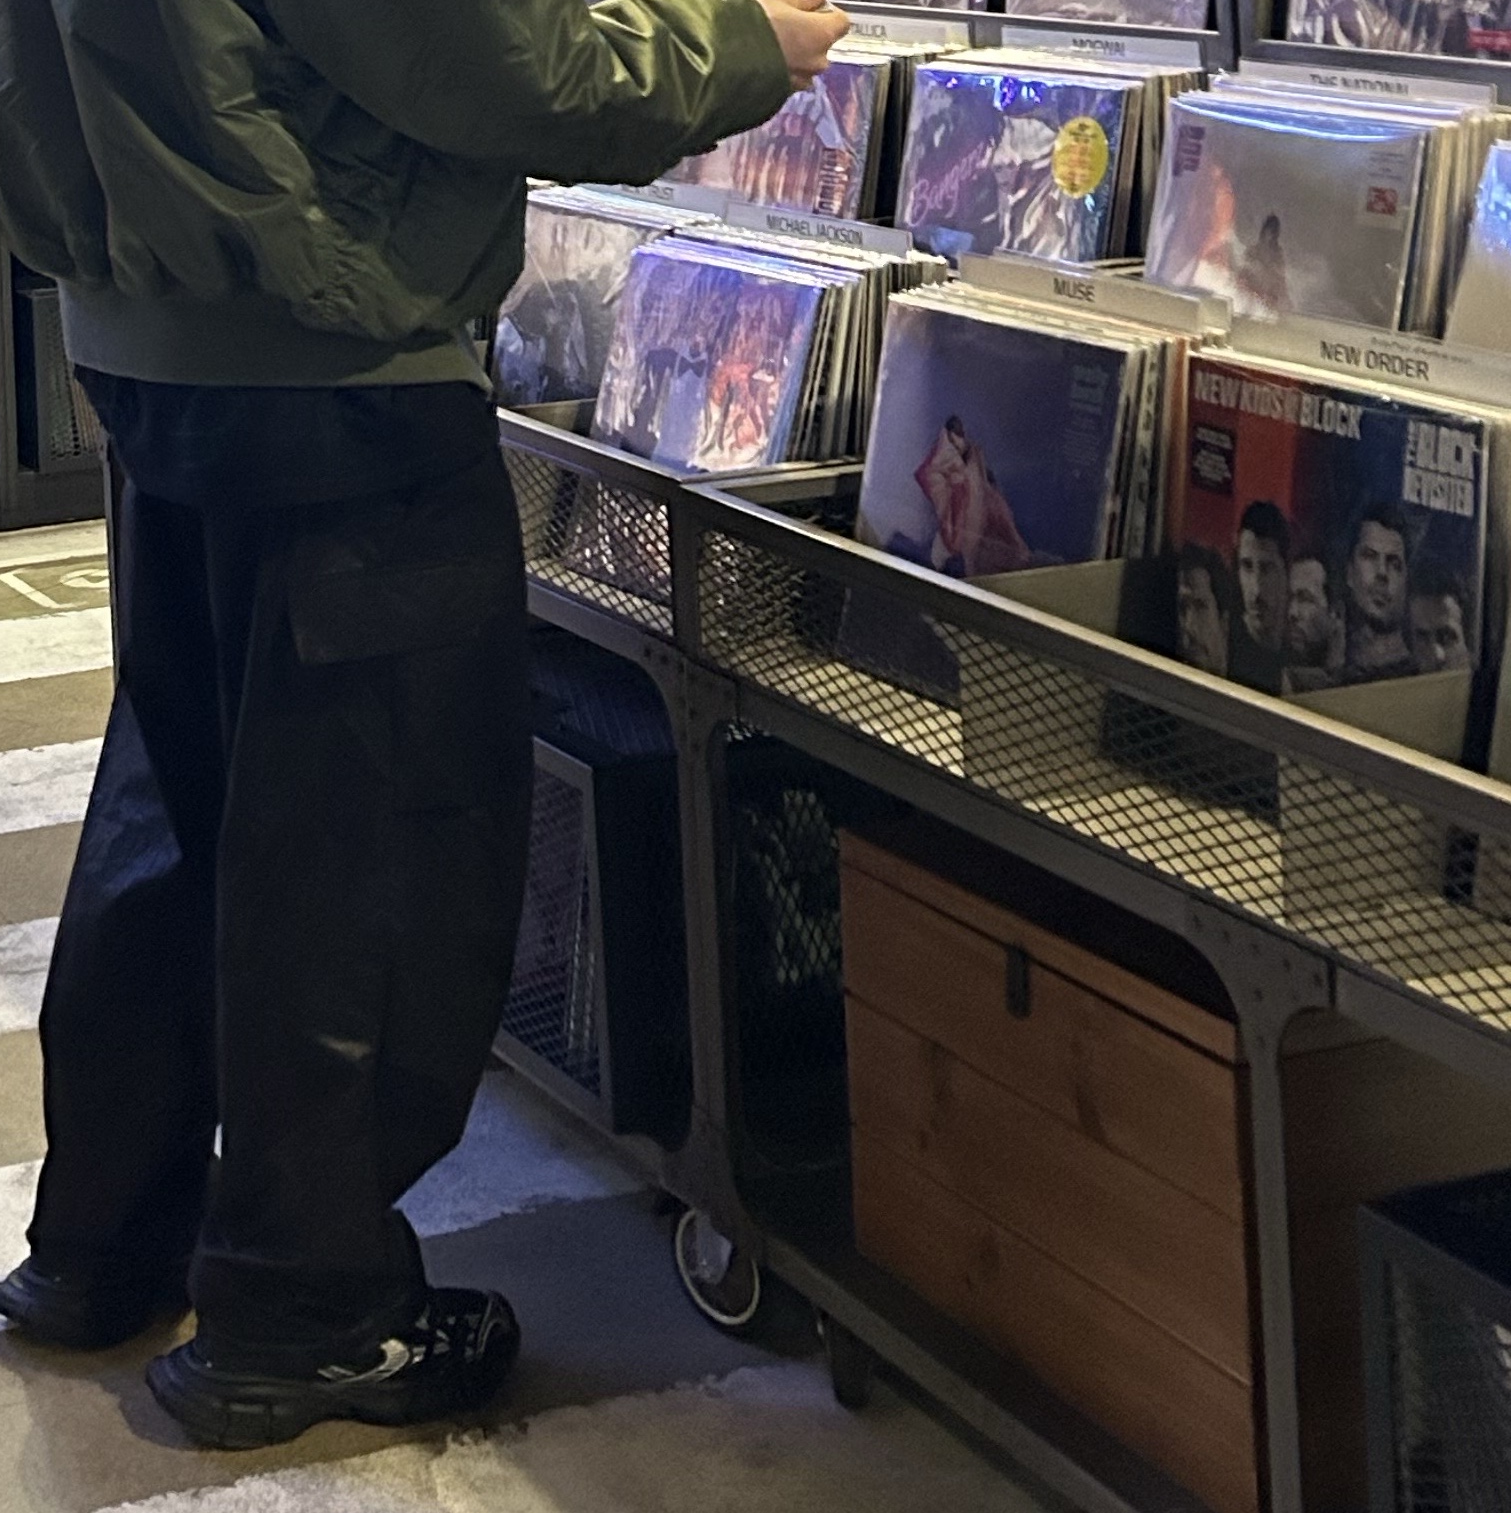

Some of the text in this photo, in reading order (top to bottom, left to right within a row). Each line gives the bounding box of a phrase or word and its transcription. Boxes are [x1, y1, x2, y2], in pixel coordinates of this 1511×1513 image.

[766, 214, 863, 246] MICHAEL JACKSON
[1053, 277, 1096, 303] MUSE
[1319, 339, 1361, 367] NEW
[1364, 349, 1430, 382] ORDER
[1193, 369, 1239, 409] NEW
[1238, 378, 1283, 420] KIDS
[1298, 390, 1362, 441] BLOCK
